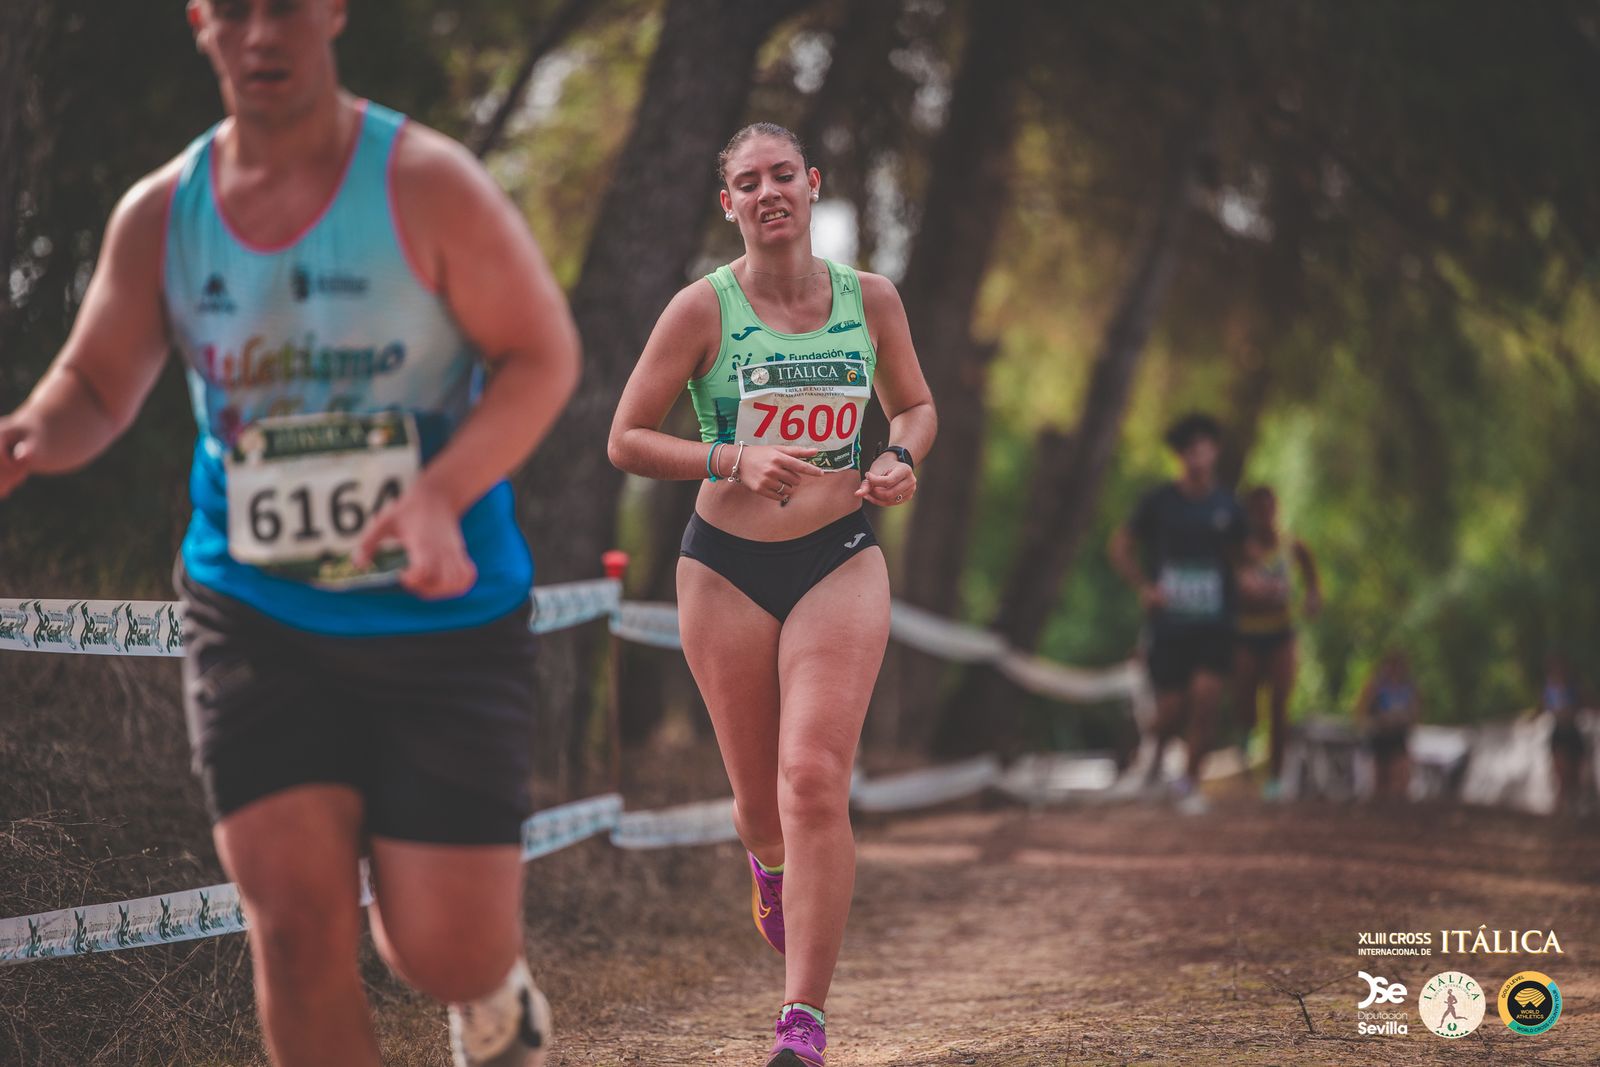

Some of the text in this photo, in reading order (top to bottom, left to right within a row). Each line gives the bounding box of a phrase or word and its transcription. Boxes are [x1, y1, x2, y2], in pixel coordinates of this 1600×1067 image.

[789, 349, 845, 360] Fundación
[778, 364, 839, 380] ITÁLICA
[753, 402, 857, 442] 7600
